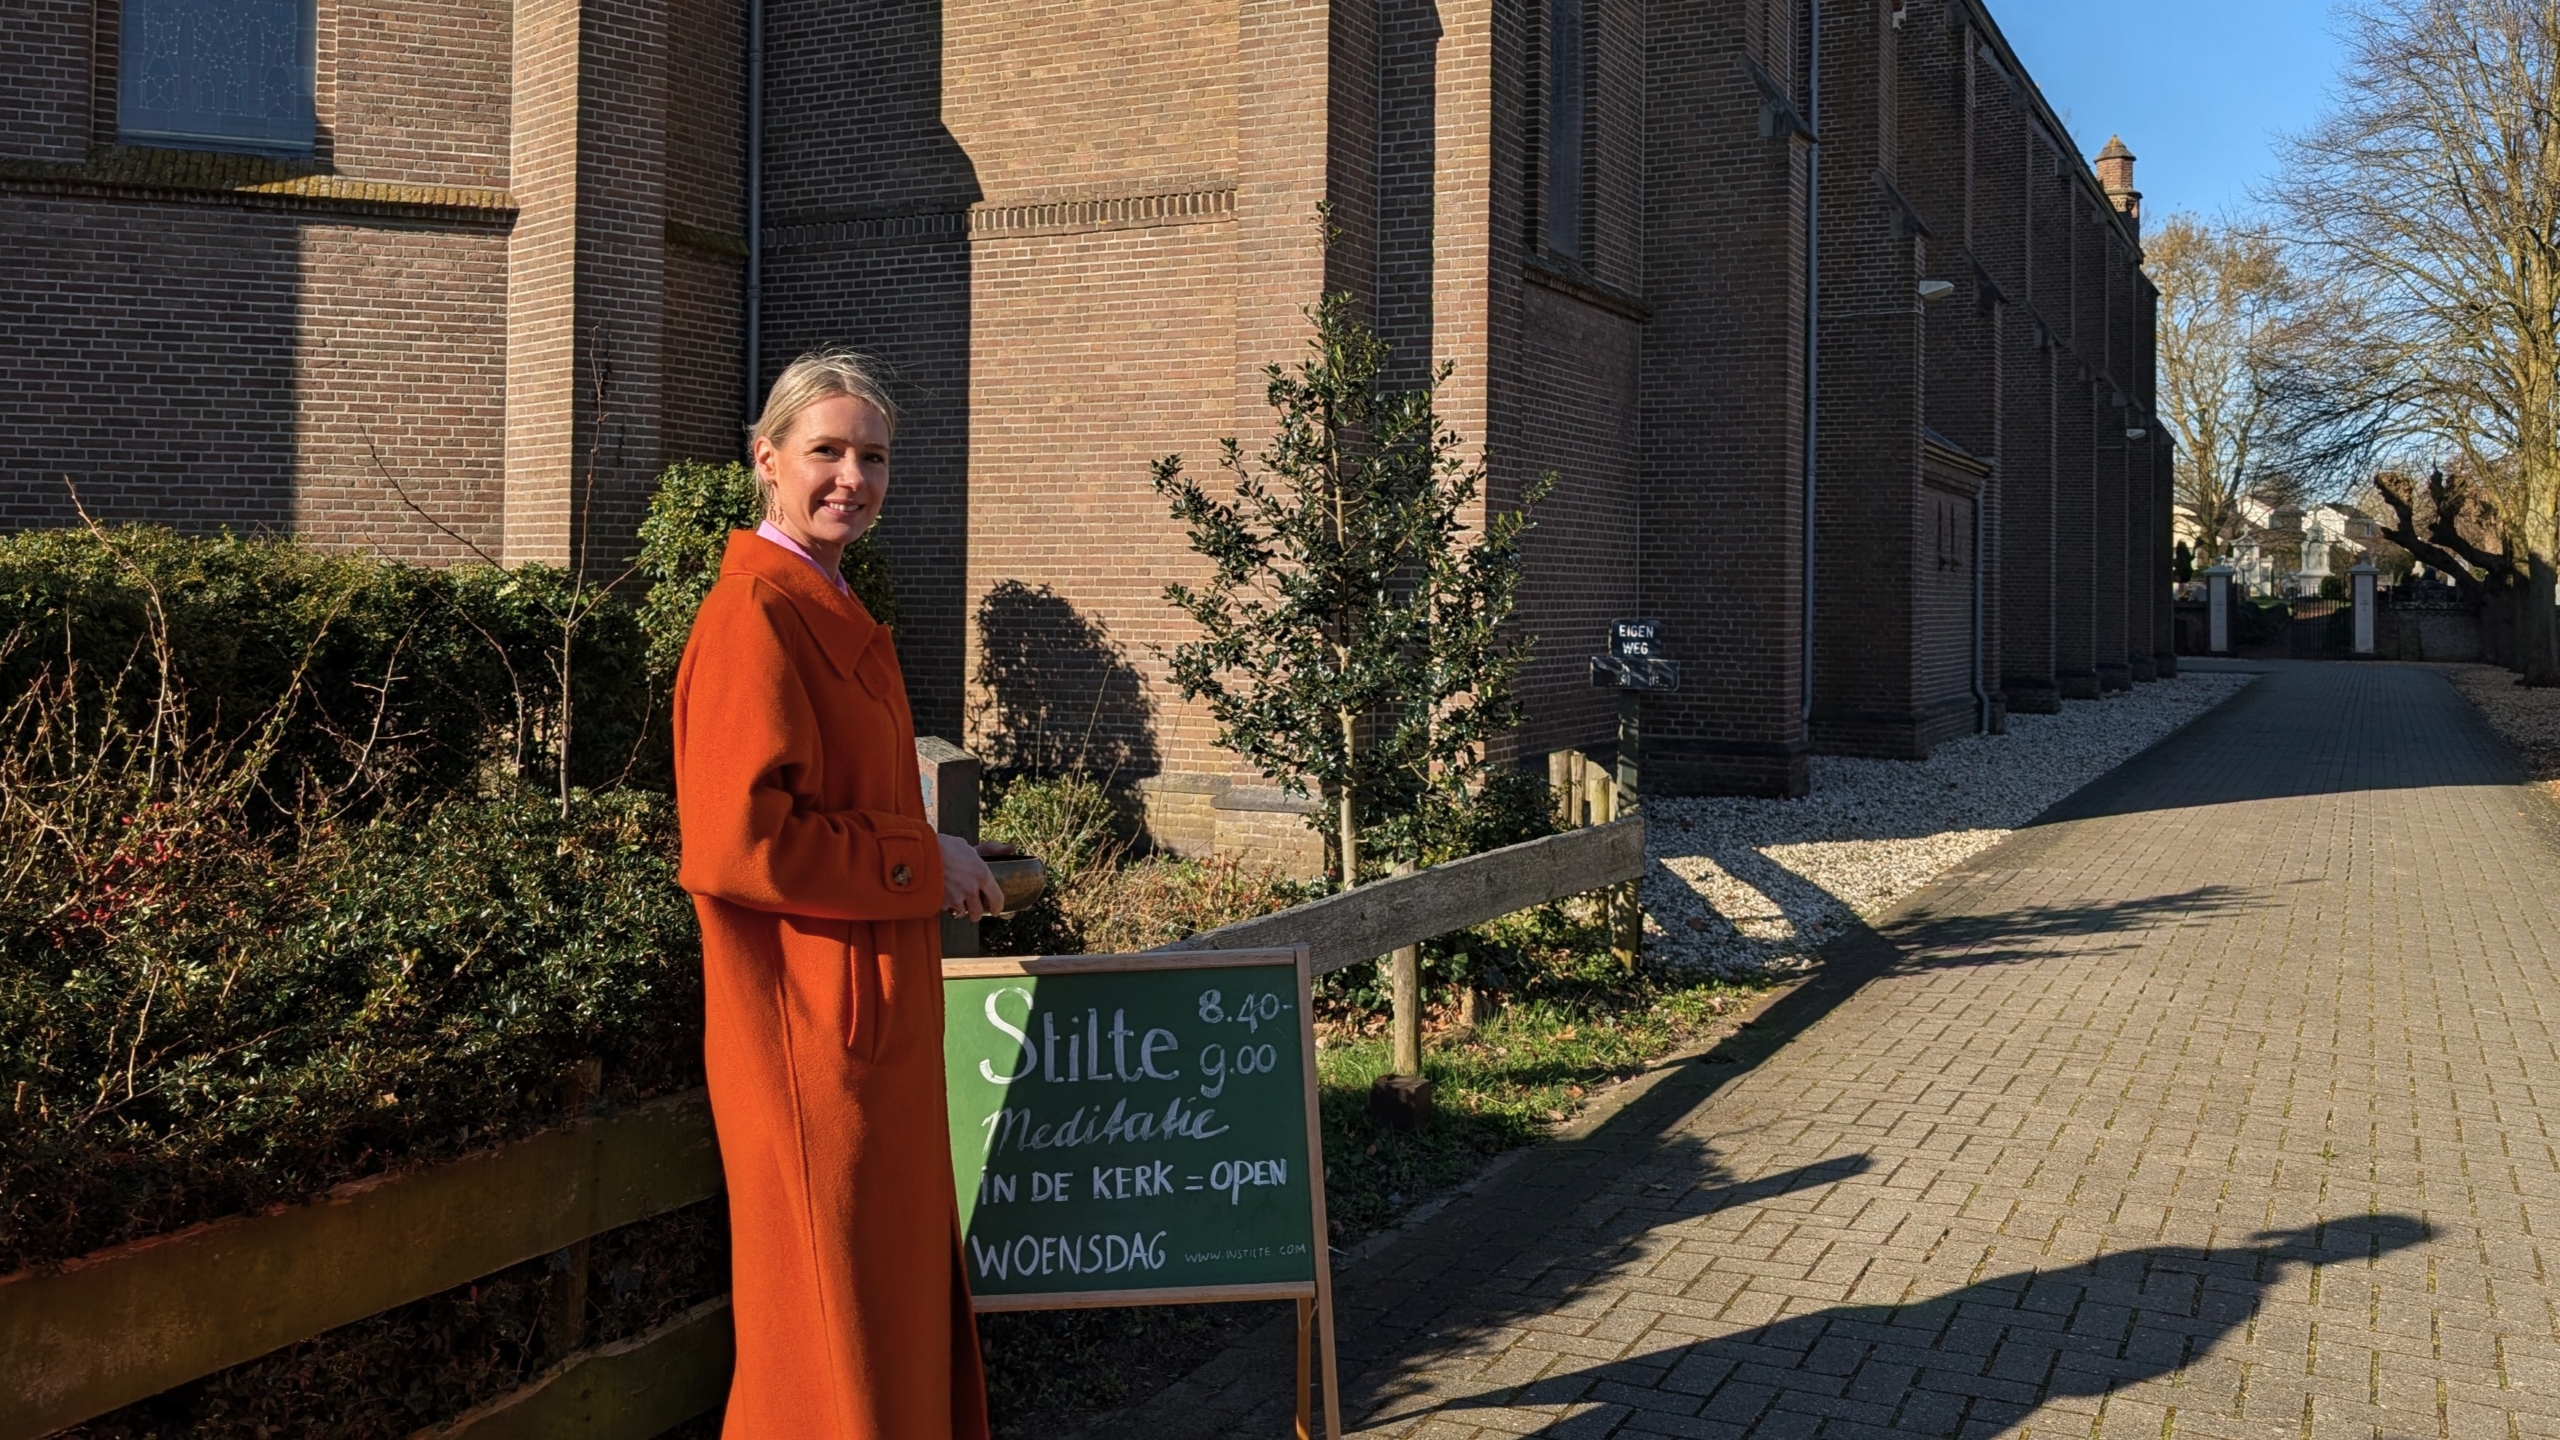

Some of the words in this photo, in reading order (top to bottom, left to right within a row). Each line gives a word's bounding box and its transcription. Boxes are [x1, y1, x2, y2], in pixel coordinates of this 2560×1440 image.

[1618, 624, 1654, 639] EIGEN
[1622, 641, 1649, 655] WEG
[1199, 1043, 1278, 1098] 9.00
[981, 1097, 1230, 1156] Meditatie
[1031, 1171, 1074, 1202] DE
[1092, 1160, 1175, 1200] KERK
[1209, 1158, 1288, 1206] OPEN
[971, 1230, 1168, 1281] WOENSDAG
